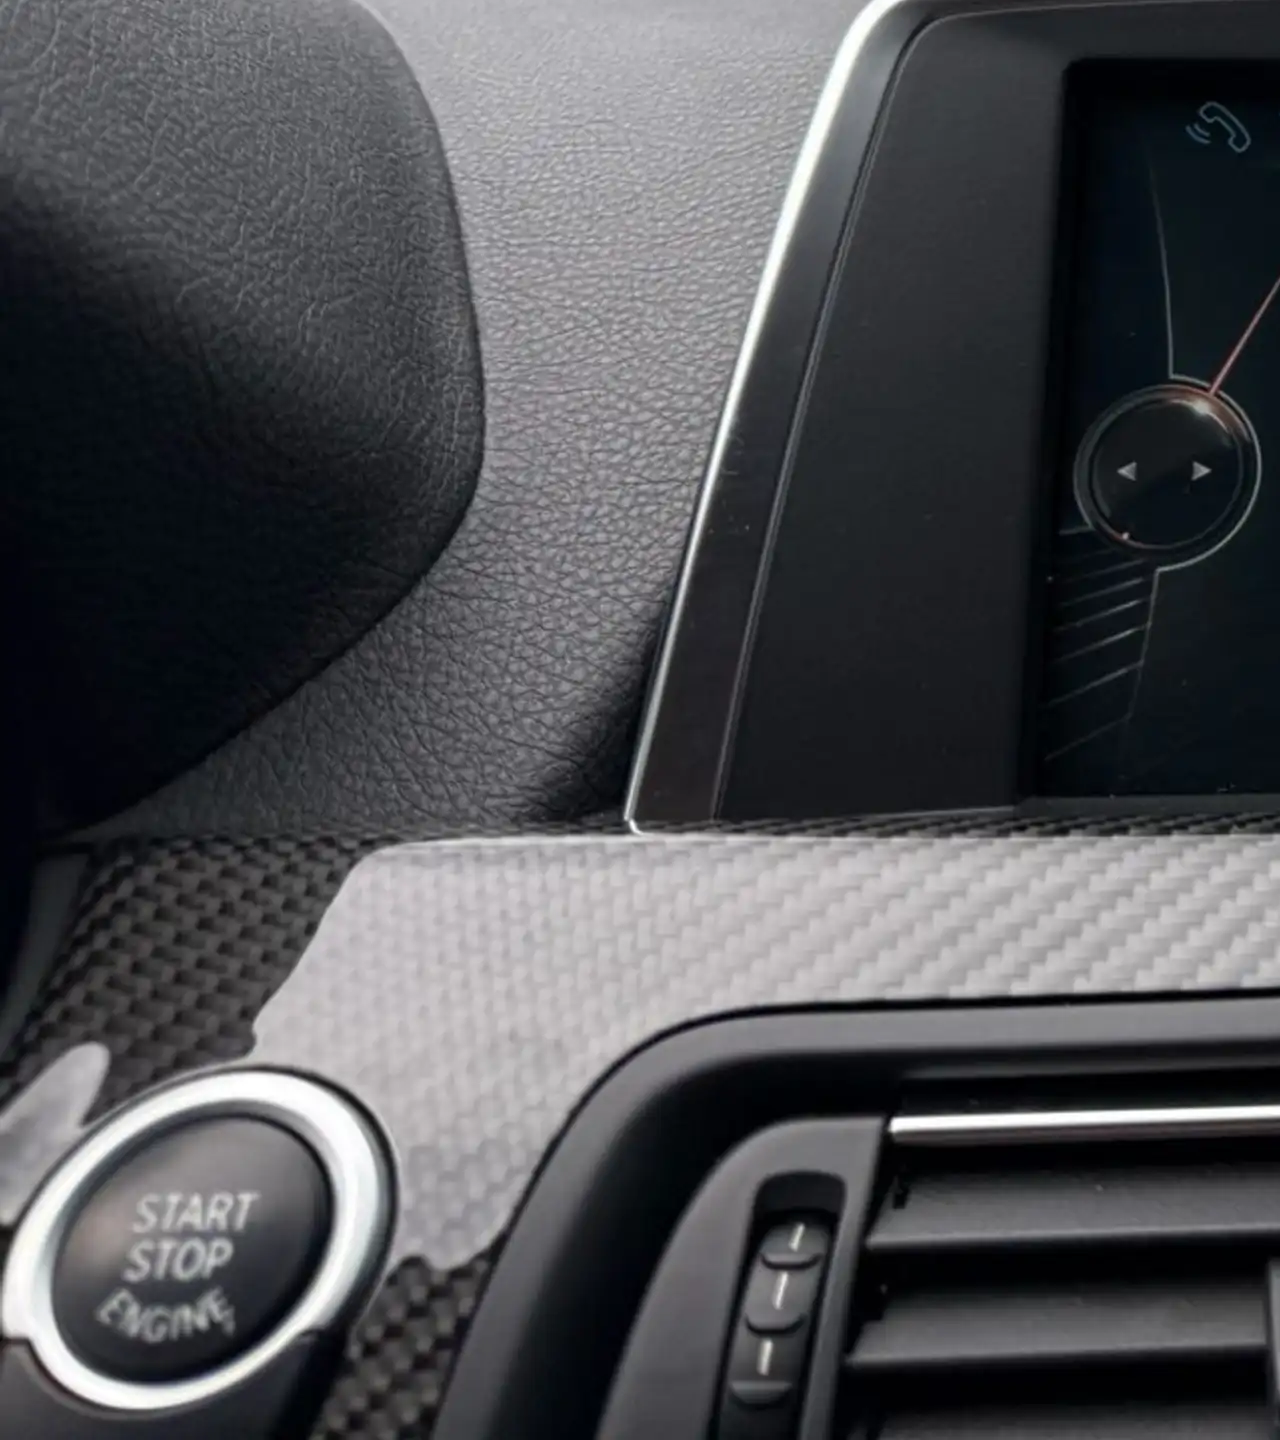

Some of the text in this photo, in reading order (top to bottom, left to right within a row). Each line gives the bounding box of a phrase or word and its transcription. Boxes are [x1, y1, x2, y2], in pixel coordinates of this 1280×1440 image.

[132, 1191, 260, 1236] START
[124, 1238, 234, 1284] STOP
[95, 1286, 236, 1345] ENGINE
